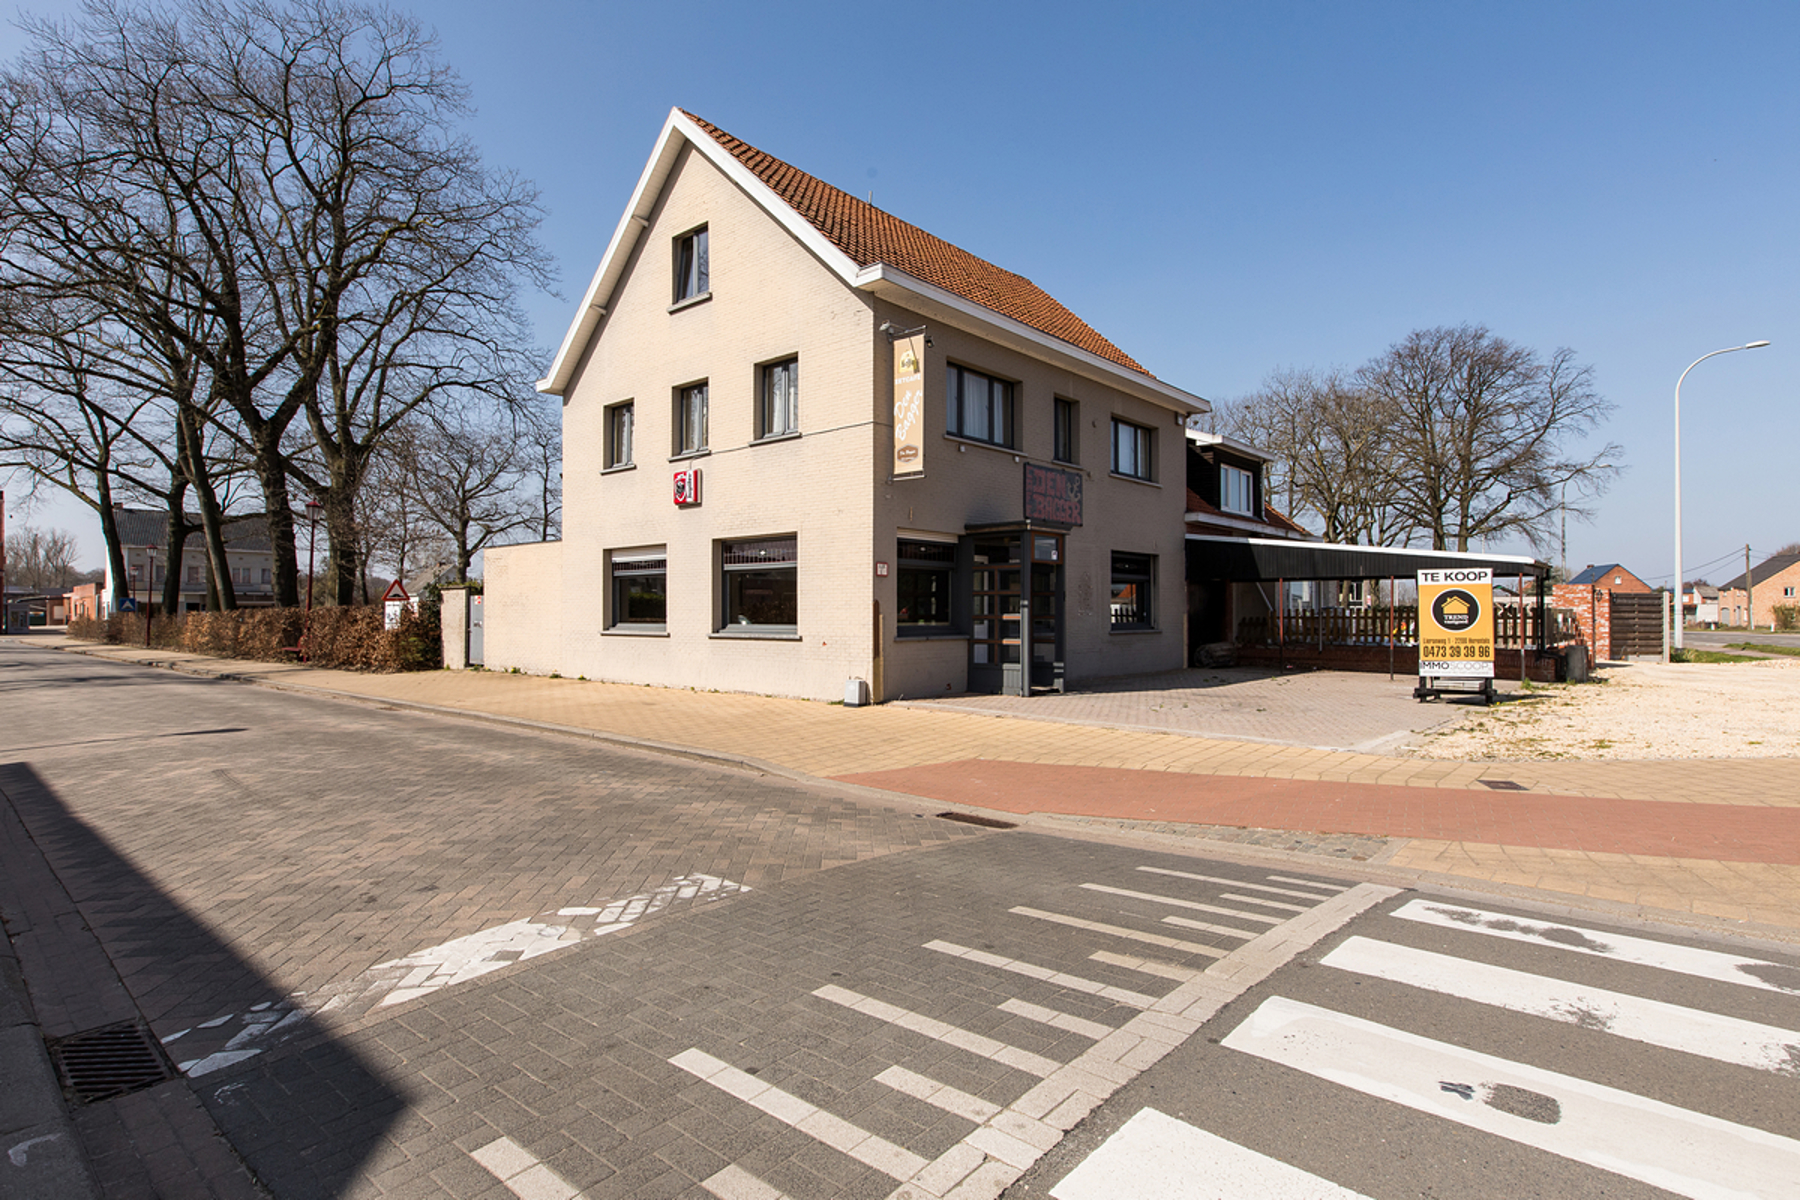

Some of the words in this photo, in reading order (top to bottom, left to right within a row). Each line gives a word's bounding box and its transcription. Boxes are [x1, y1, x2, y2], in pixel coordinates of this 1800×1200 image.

[1033, 468, 1066, 499] DEN
[1033, 493, 1082, 524] BAGGER
[1421, 572, 1440, 582] TE
[1444, 571, 1488, 582] KOOP
[1423, 645, 1447, 658] 0473
[1449, 645, 1461, 658] 39
[1463, 645, 1475, 658] 39
[1478, 645, 1490, 658] 96
